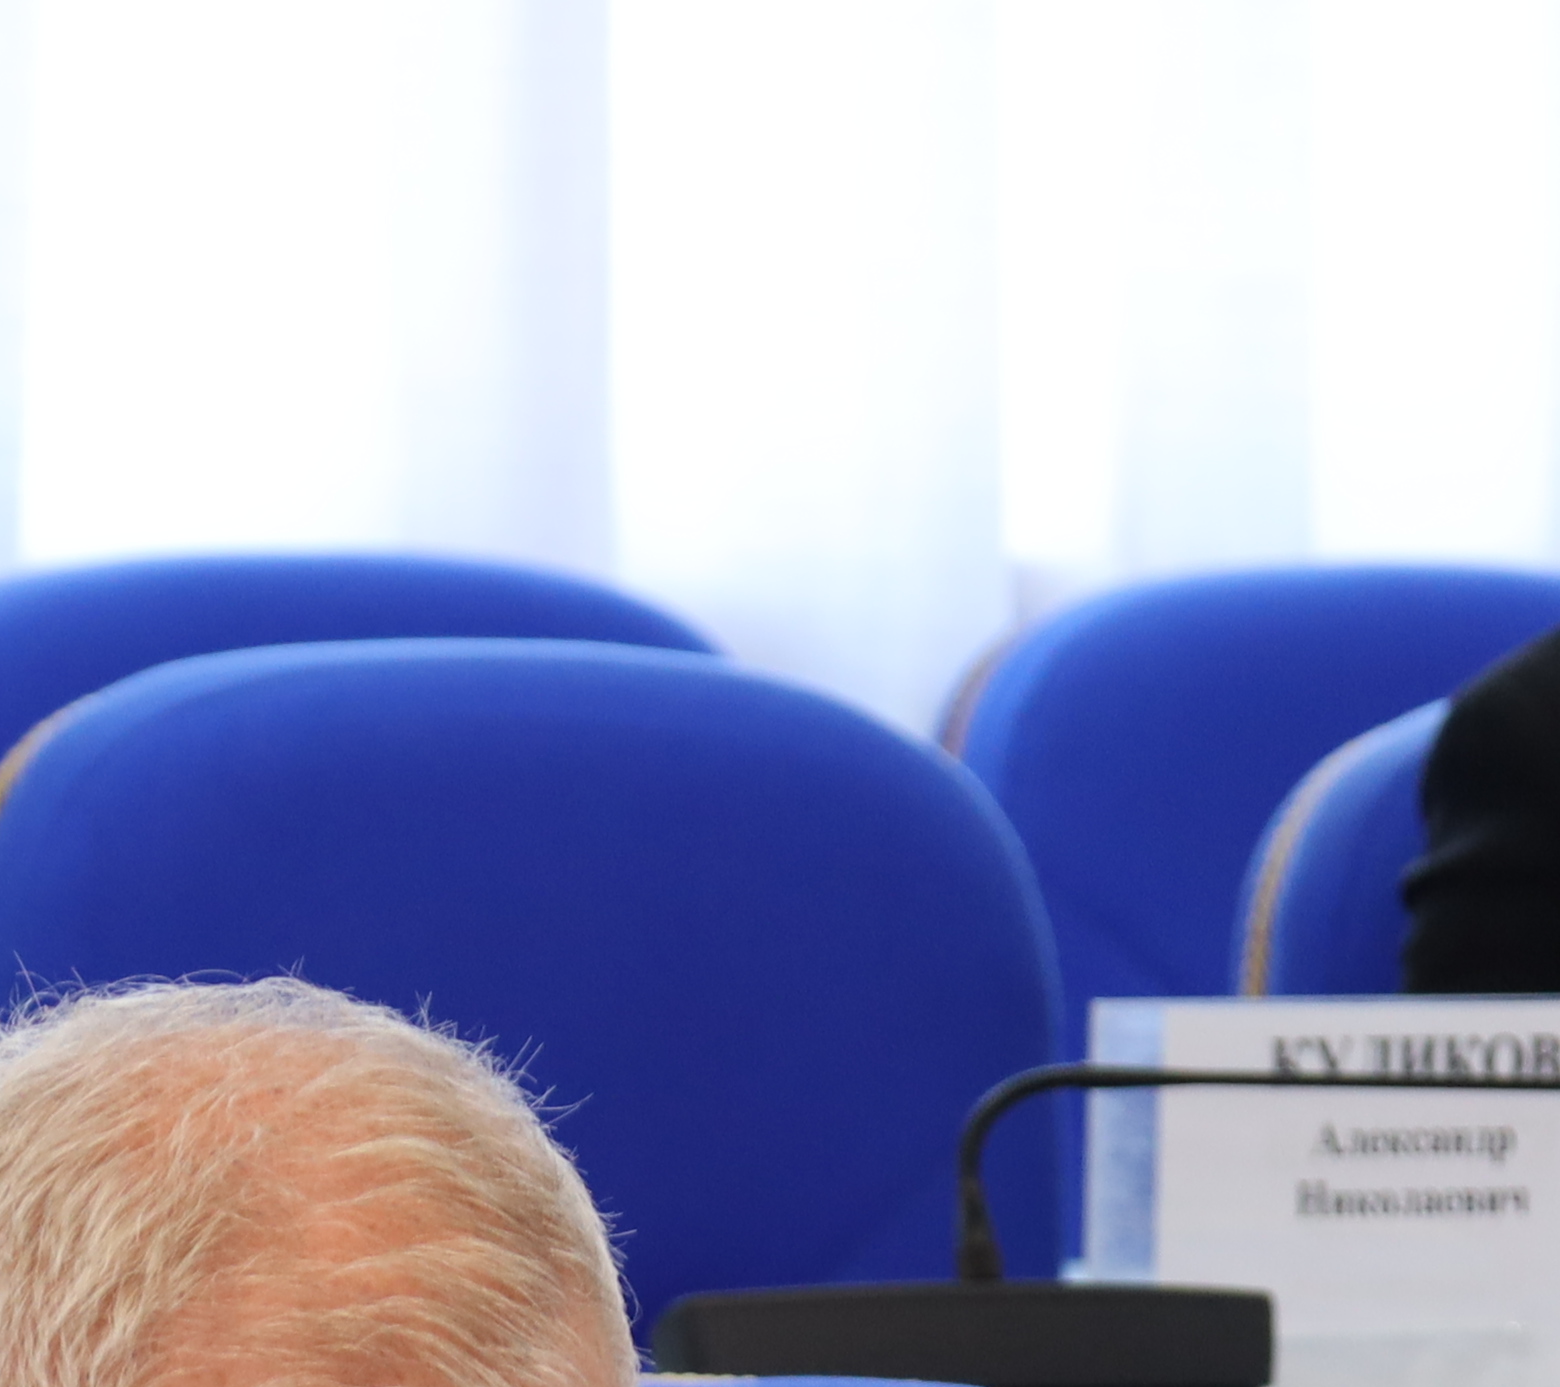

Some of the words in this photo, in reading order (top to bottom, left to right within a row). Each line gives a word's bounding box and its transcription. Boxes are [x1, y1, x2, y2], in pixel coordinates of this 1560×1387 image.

[1271, 1034, 1560, 1076] КУЛИКОВ
[1314, 1121, 1519, 1166] Александр
[1295, 1179, 1531, 1217] Николаевич
